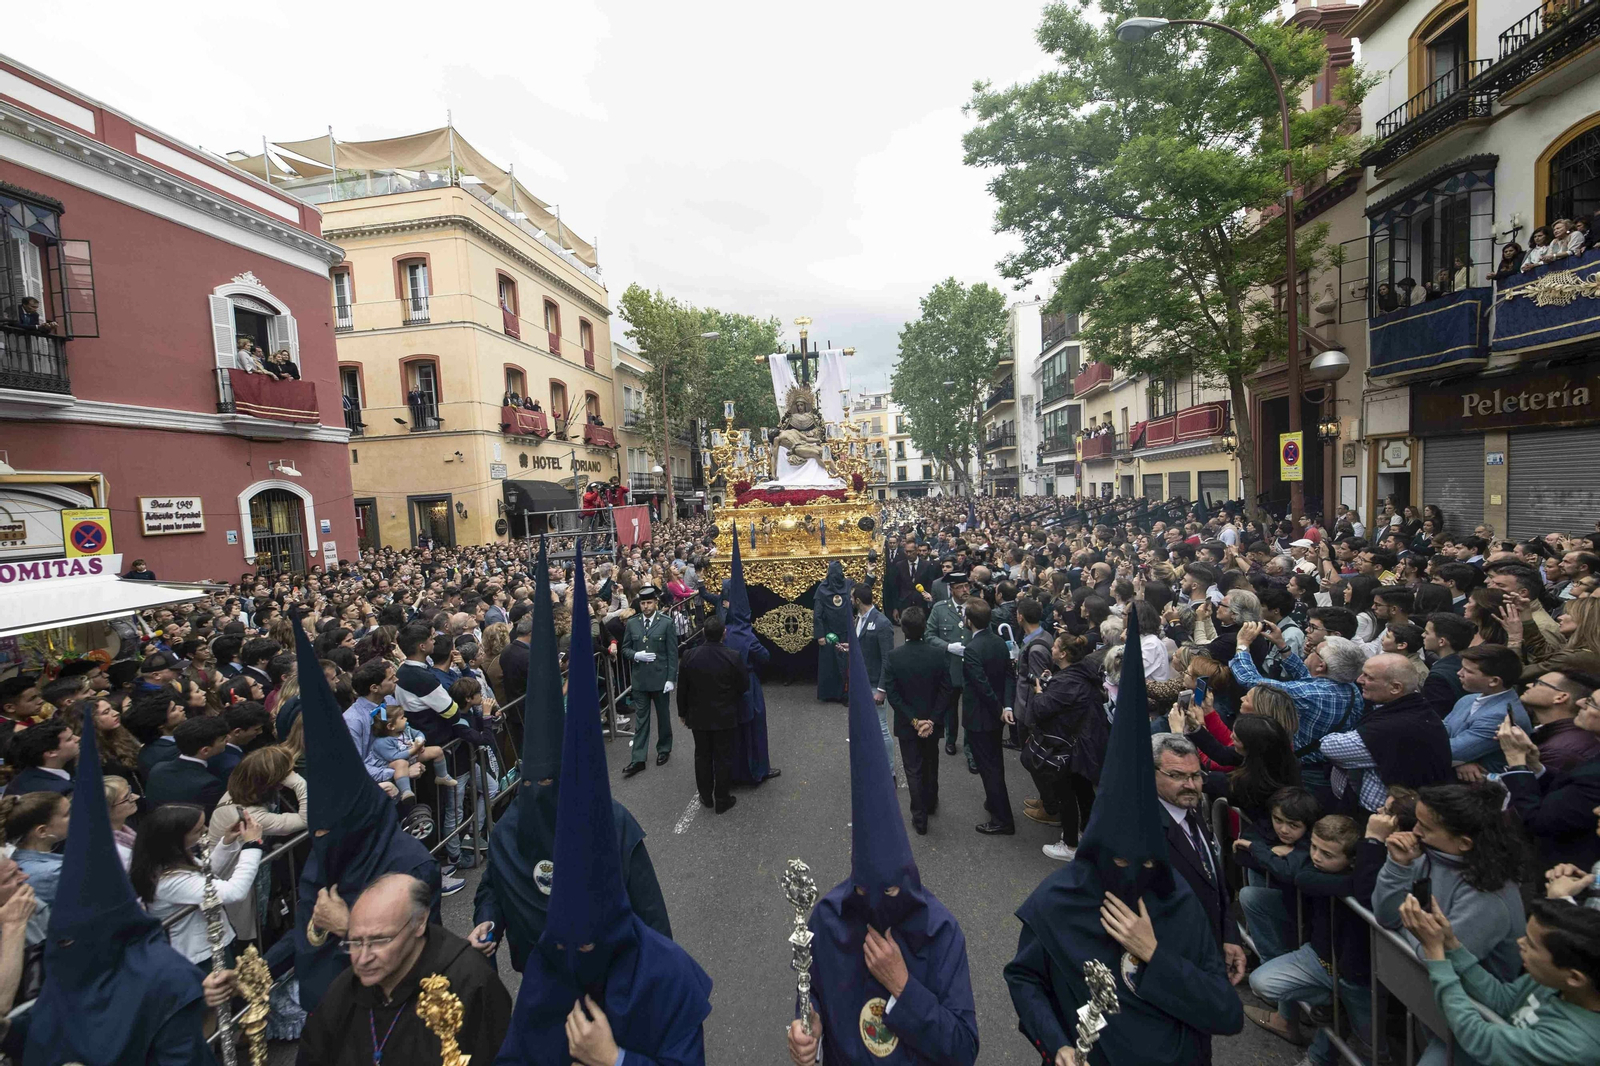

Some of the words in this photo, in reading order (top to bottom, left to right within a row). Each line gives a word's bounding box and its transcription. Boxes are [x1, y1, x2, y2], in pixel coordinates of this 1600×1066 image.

[1461, 380, 1592, 418] Peletería
[532, 455, 562, 470] HOTEL
[150, 499, 174, 509] Desde
[175, 510, 201, 521] Español
[0, 557, 103, 584] OMITAS
